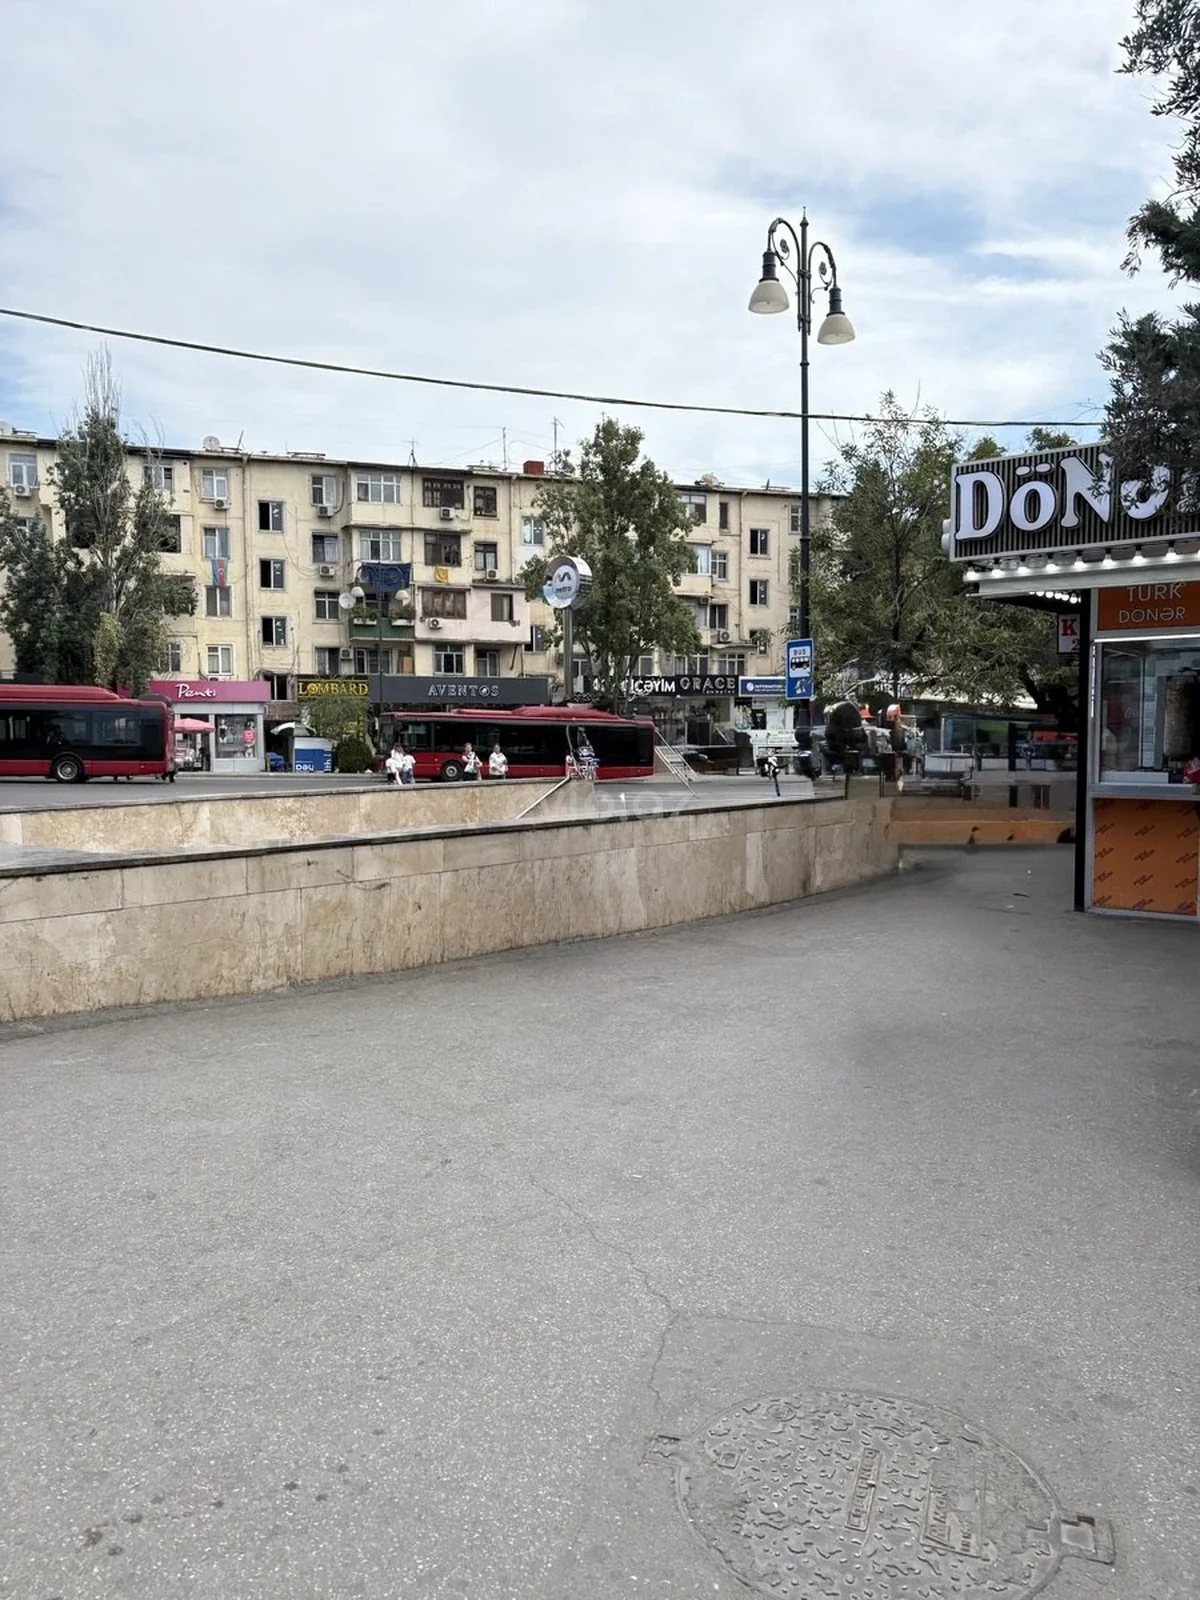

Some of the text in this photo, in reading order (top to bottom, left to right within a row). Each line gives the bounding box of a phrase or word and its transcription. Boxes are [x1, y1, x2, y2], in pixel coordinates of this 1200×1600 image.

[175, 683, 217, 698] Penti
[297, 682, 369, 695] LOMBARD
[427, 684, 500, 697] AVENTOS
[679, 676, 736, 693] GRACE
